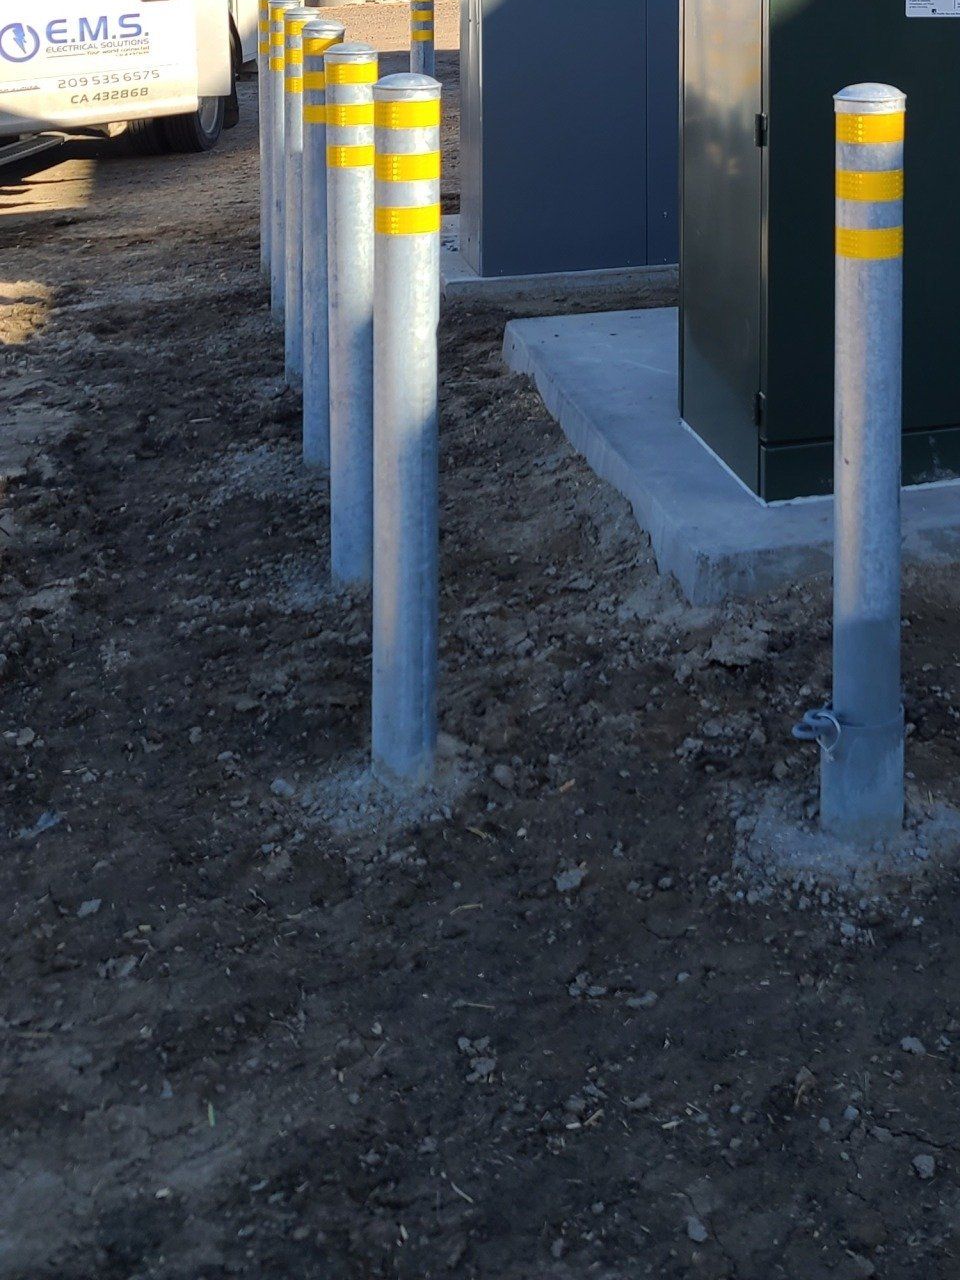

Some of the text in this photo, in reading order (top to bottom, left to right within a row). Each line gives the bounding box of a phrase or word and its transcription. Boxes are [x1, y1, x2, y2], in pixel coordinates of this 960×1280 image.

[45, 13, 149, 44] E.M.S.
[45, 38, 149, 53] ELECTRICAL SOLUTIONS
[58, 70, 160, 89] 209 535 6575
[70, 87, 149, 104] CA 432868
